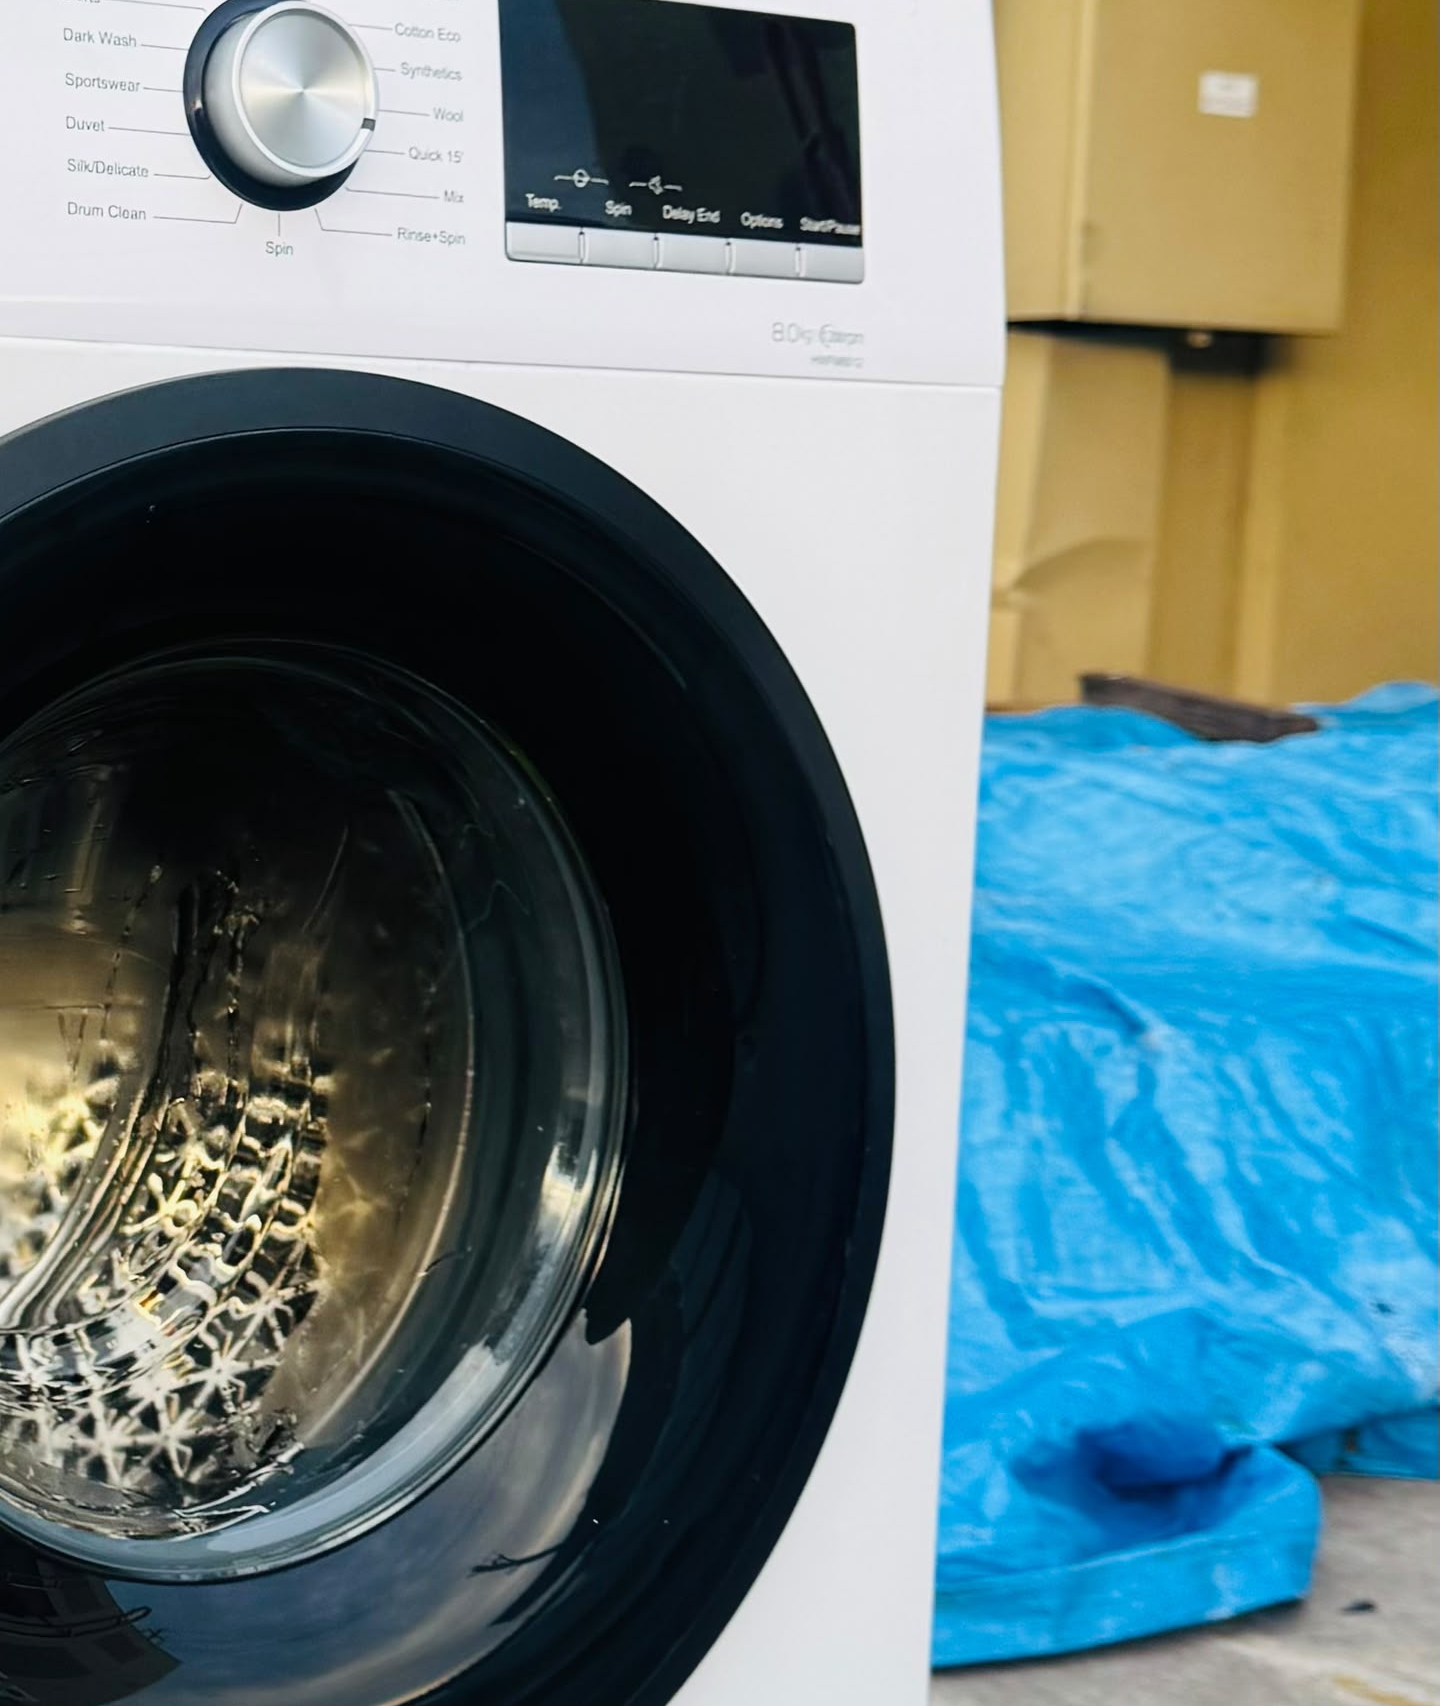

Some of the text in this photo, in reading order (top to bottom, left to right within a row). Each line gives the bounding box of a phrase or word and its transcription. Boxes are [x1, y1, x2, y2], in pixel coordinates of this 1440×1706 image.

[63, 27, 137, 47] Dark Wash
[394, 22, 461, 42] Cotton Eco
[400, 61, 463, 81] Synthetics
[65, 72, 141, 92] Sportswear
[65, 116, 105, 132] Duvet
[433, 107, 464, 123] Wool
[408, 146, 442, 162] Quick
[67, 158, 150, 178] Silk/Delicate
[67, 201, 147, 221] Drum Clean
[526, 193, 562, 212] Temp.
[605, 200, 632, 216] Spin
[662, 205, 720, 224] Delay End
[740, 211, 783, 229] Options
[265, 240, 294, 258] Spin
